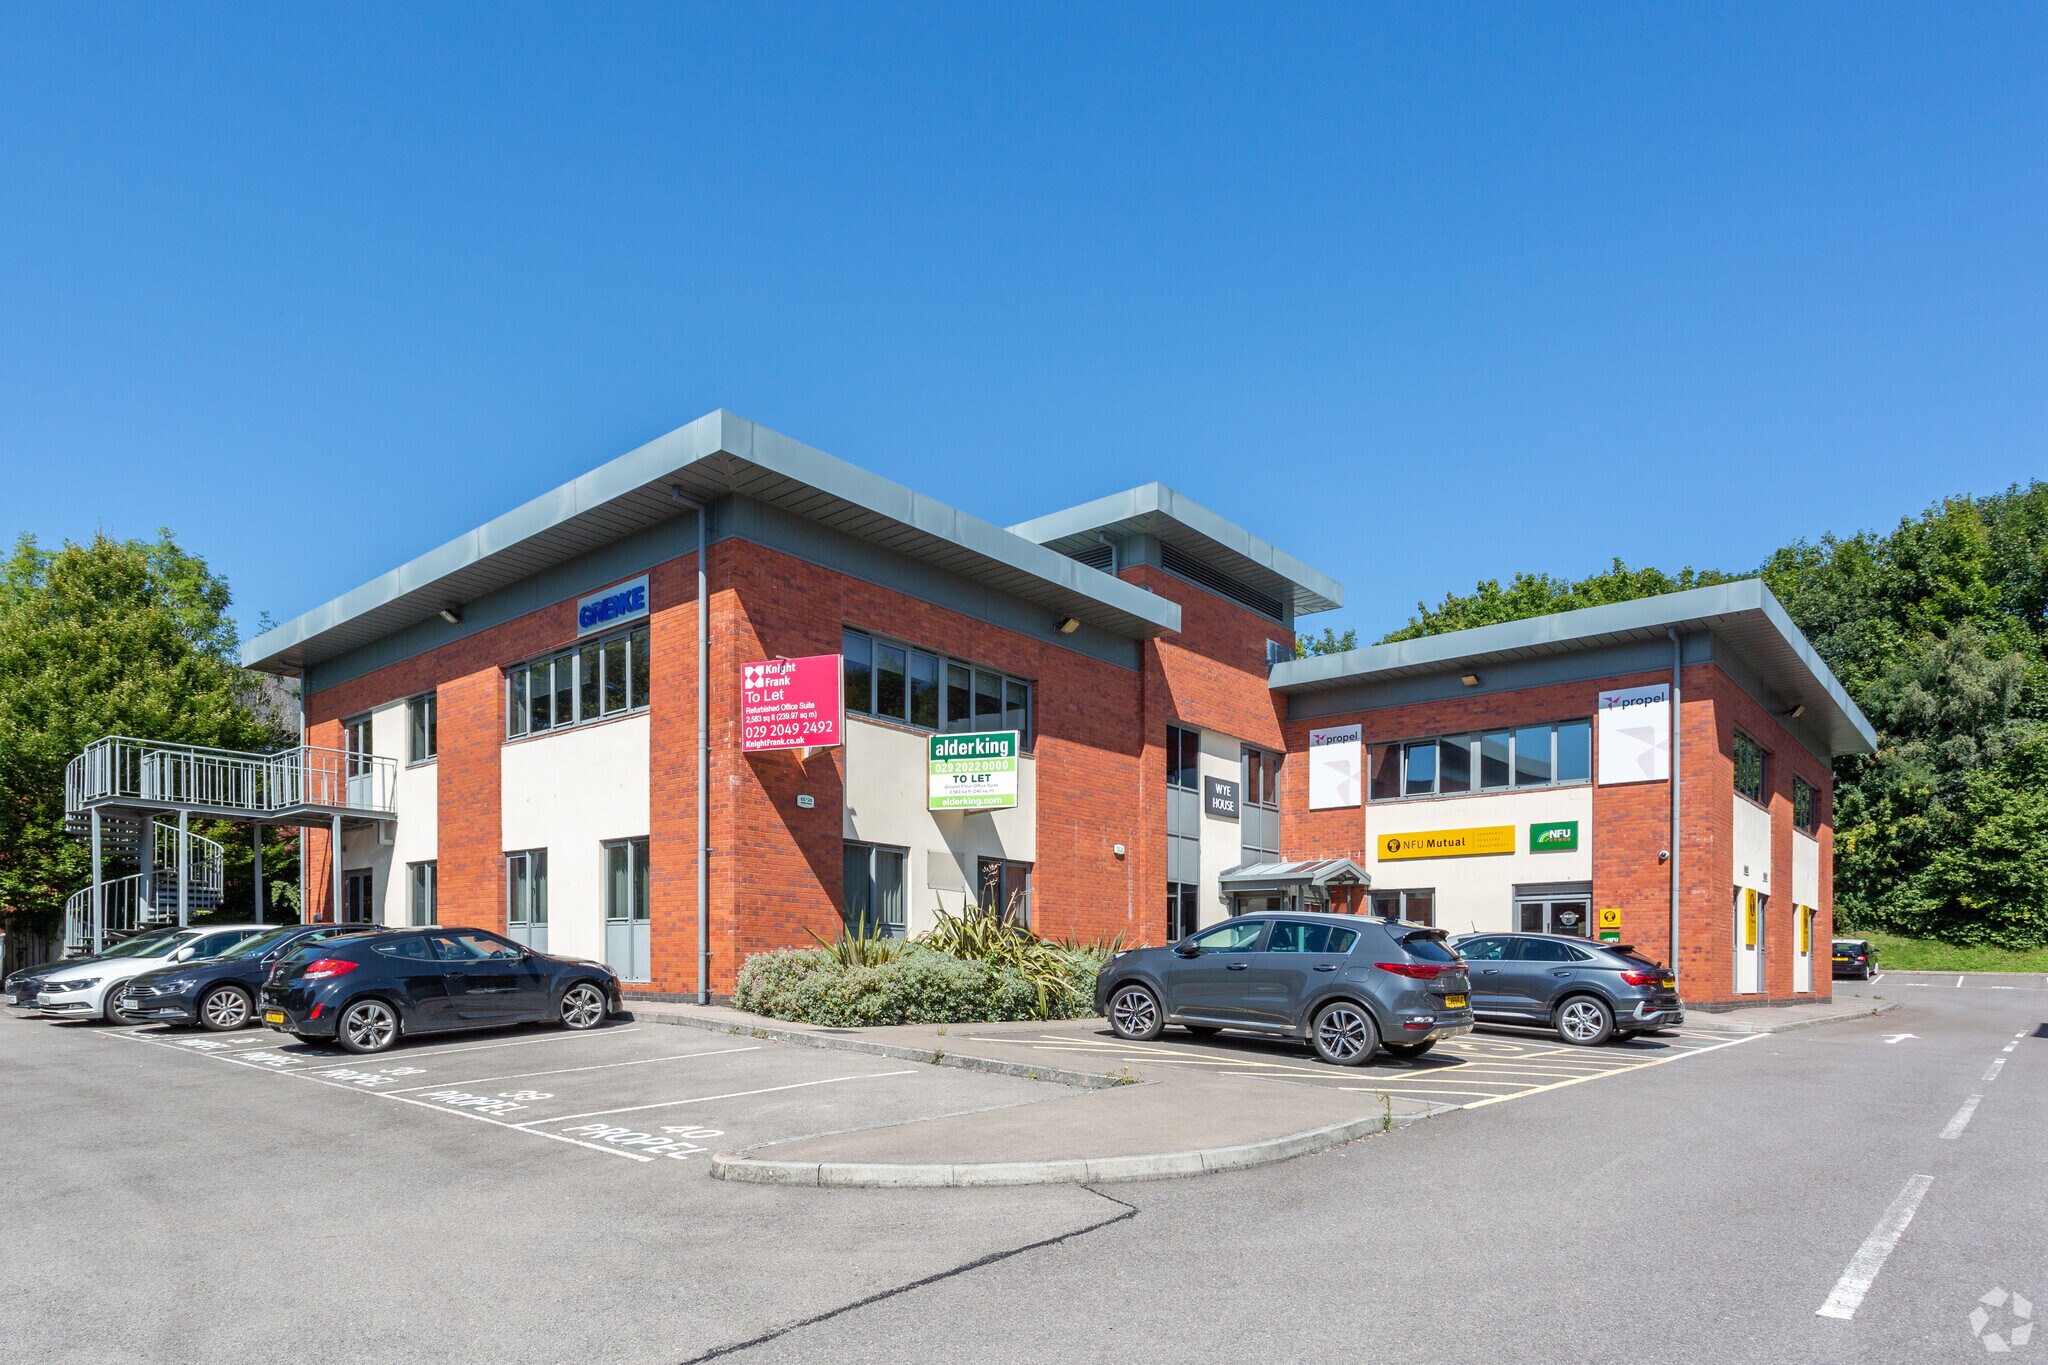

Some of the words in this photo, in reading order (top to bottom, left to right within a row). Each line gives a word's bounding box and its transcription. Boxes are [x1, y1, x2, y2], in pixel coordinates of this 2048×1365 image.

[766, 663, 796, 674] Knight
[766, 676, 790, 686] Frank
[745, 691, 760, 703] To
[764, 689, 784, 702] Let
[1622, 692, 1664, 710] propel
[746, 704, 780, 714] Refurbished
[808, 710, 818, 719] m)
[746, 726, 766, 738] 029
[770, 722, 800, 736] 2049
[802, 720, 832, 734] 2492
[746, 736, 804, 748] KnightFrank.co.uk
[1326, 732, 1358, 746] propel
[935, 738, 1008, 756] alderking
[936, 763, 954, 773] 029
[956, 762, 980, 772] 2022
[982, 760, 1008, 770] 0000
[952, 774, 968, 784] TO
[972, 774, 992, 782] LET
[1215, 782, 1232, 796] WYE
[942, 797, 1002, 806] alderking.com
[1212, 797, 1234, 812] HOUSE
[1550, 828, 1570, 838] NFU
[1403, 840, 1424, 850] NFU
[1426, 837, 1466, 848] Mutual
[416, 1090, 529, 1116] PROPEL
[660, 1125, 726, 1138] 40
[561, 1123, 708, 1160] PROPEL
